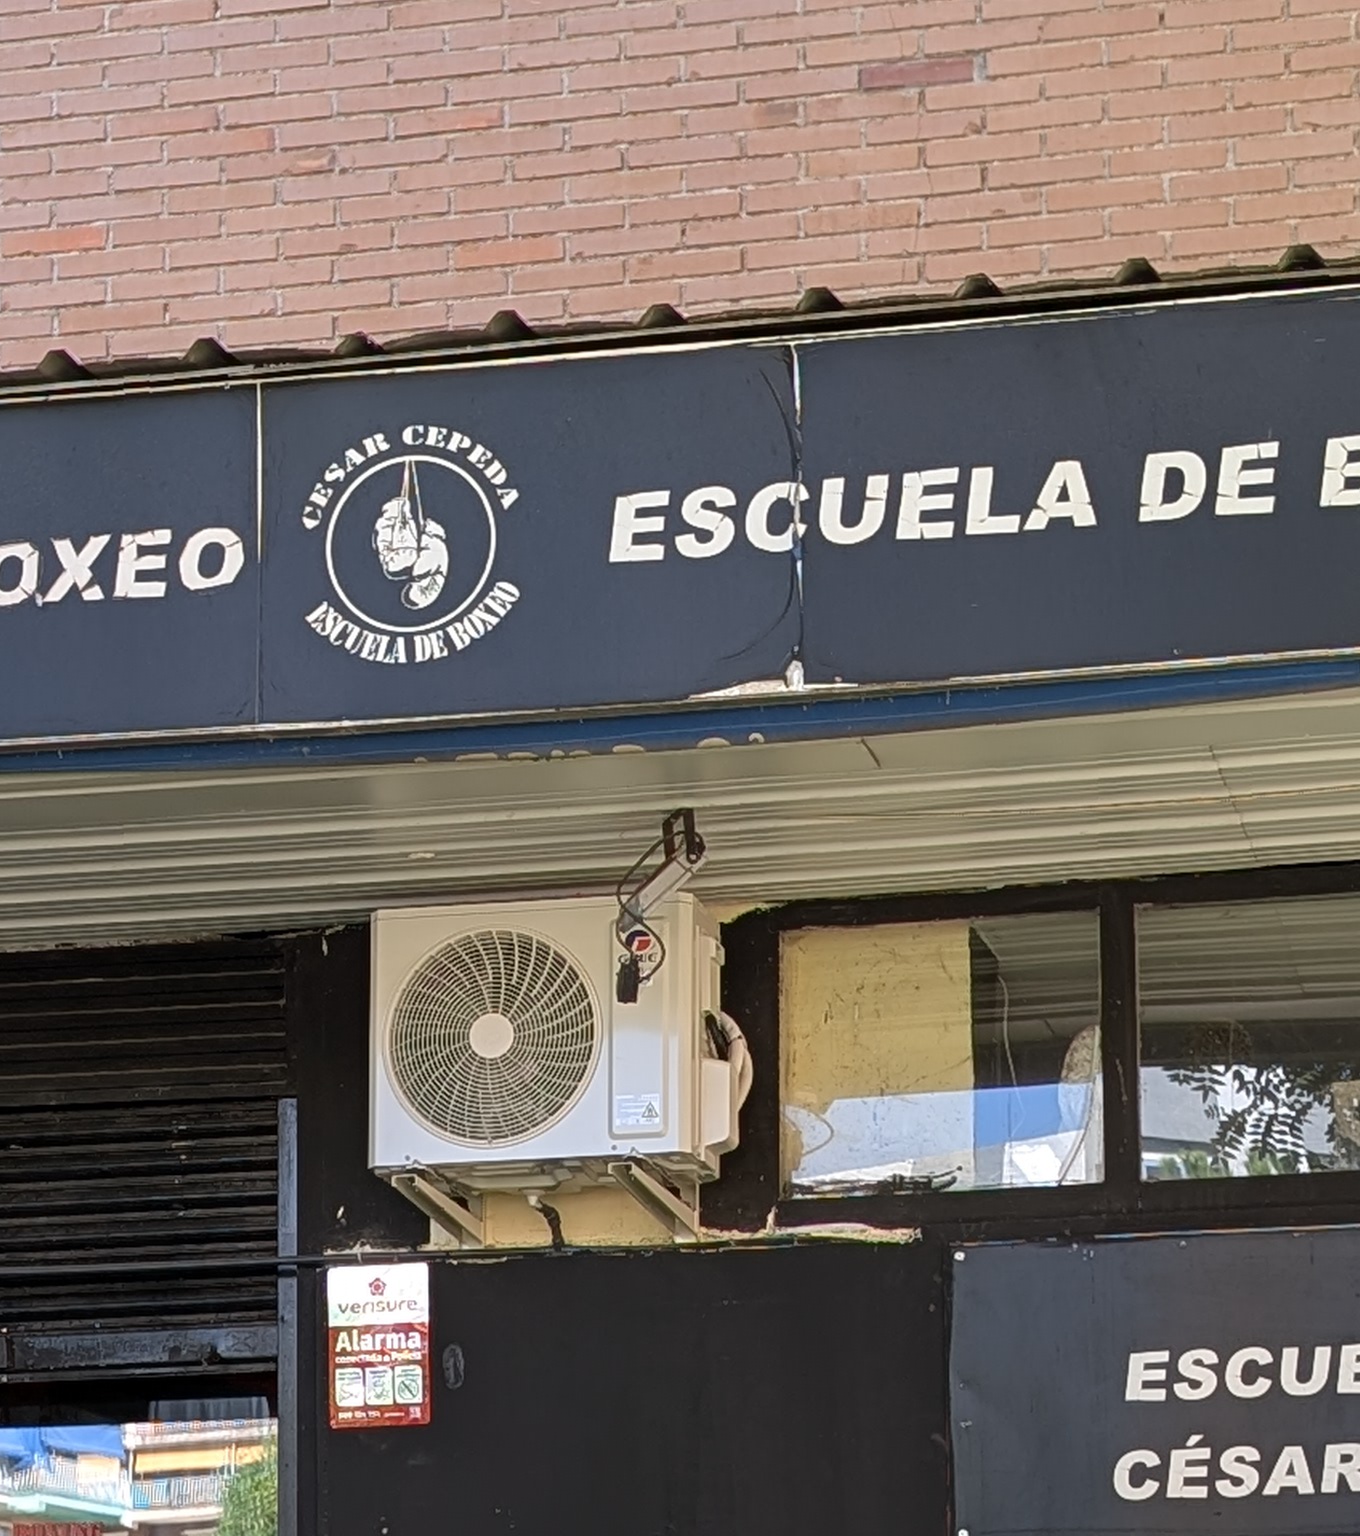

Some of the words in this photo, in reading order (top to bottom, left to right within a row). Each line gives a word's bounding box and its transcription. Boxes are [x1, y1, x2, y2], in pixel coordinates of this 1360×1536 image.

[301, 432, 391, 530] CESAR
[402, 425, 521, 511] CEPEDA
[609, 461, 1097, 563] ESCUELA
[1139, 441, 1280, 523] DE
[304, 601, 408, 664] ESCUELA
[414, 630, 449, 663] DE
[446, 581, 521, 651] BOXEO
[335, 1329, 421, 1352] Alarma
[338, 1300, 418, 1315] verisure
